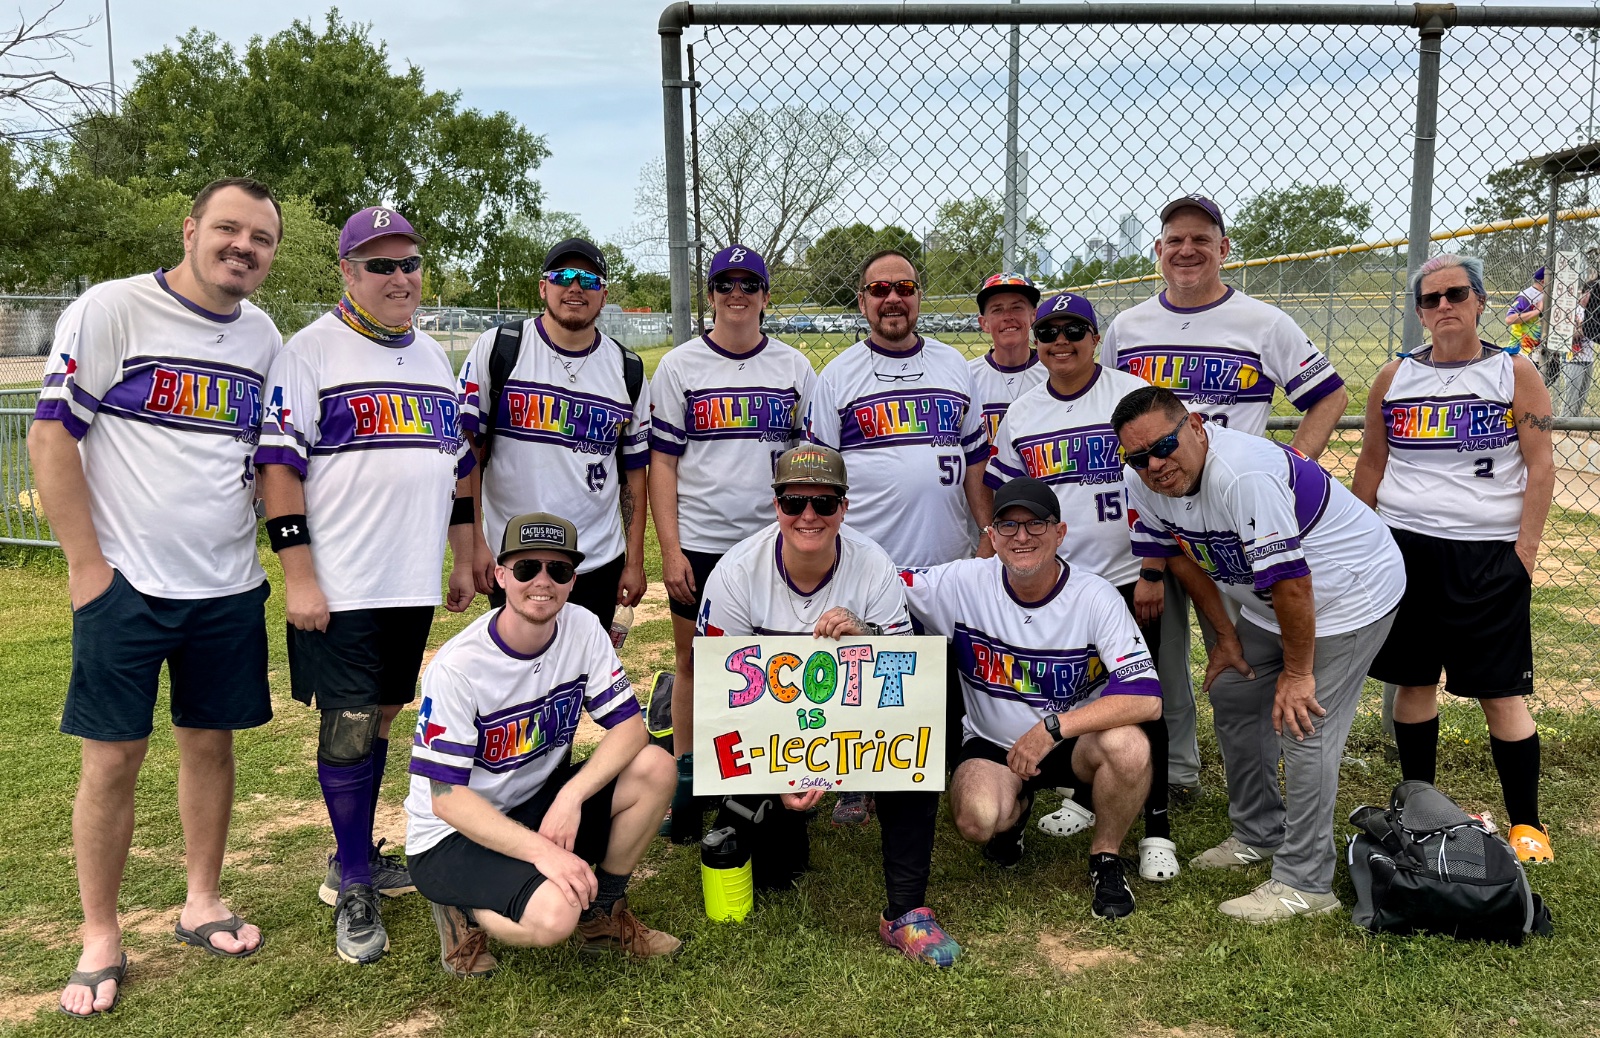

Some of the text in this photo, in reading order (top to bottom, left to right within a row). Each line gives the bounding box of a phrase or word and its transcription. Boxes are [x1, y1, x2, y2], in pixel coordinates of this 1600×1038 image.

[371, 209, 391, 229] B
[728, 247, 747, 263] B
[1052, 295, 1072, 312] B
[1127, 355, 1242, 393] BALL'RZ
[145, 367, 262, 428] BALL'R
[1187, 393, 1237, 406] AUSTIN
[347, 392, 460, 440] BALL'R
[508, 391, 622, 443] BALL'RZ
[1391, 403, 1508, 440] BALL'RZ
[573, 440, 616, 456] AUSTI
[1457, 435, 1512, 453] AUSTIN
[1019, 434, 1122, 479] BALL'RZ
[936, 454, 963, 486] 57
[1079, 470, 1124, 487] AUSTIN
[1473, 457, 1495, 479] 2
[1094, 490, 1122, 523] 15
[522, 526, 564, 537] CACTUS ROPES
[528, 532, 558, 540] TEXAS
[725, 644, 917, 708] SCOTT
[797, 708, 826, 730] is
